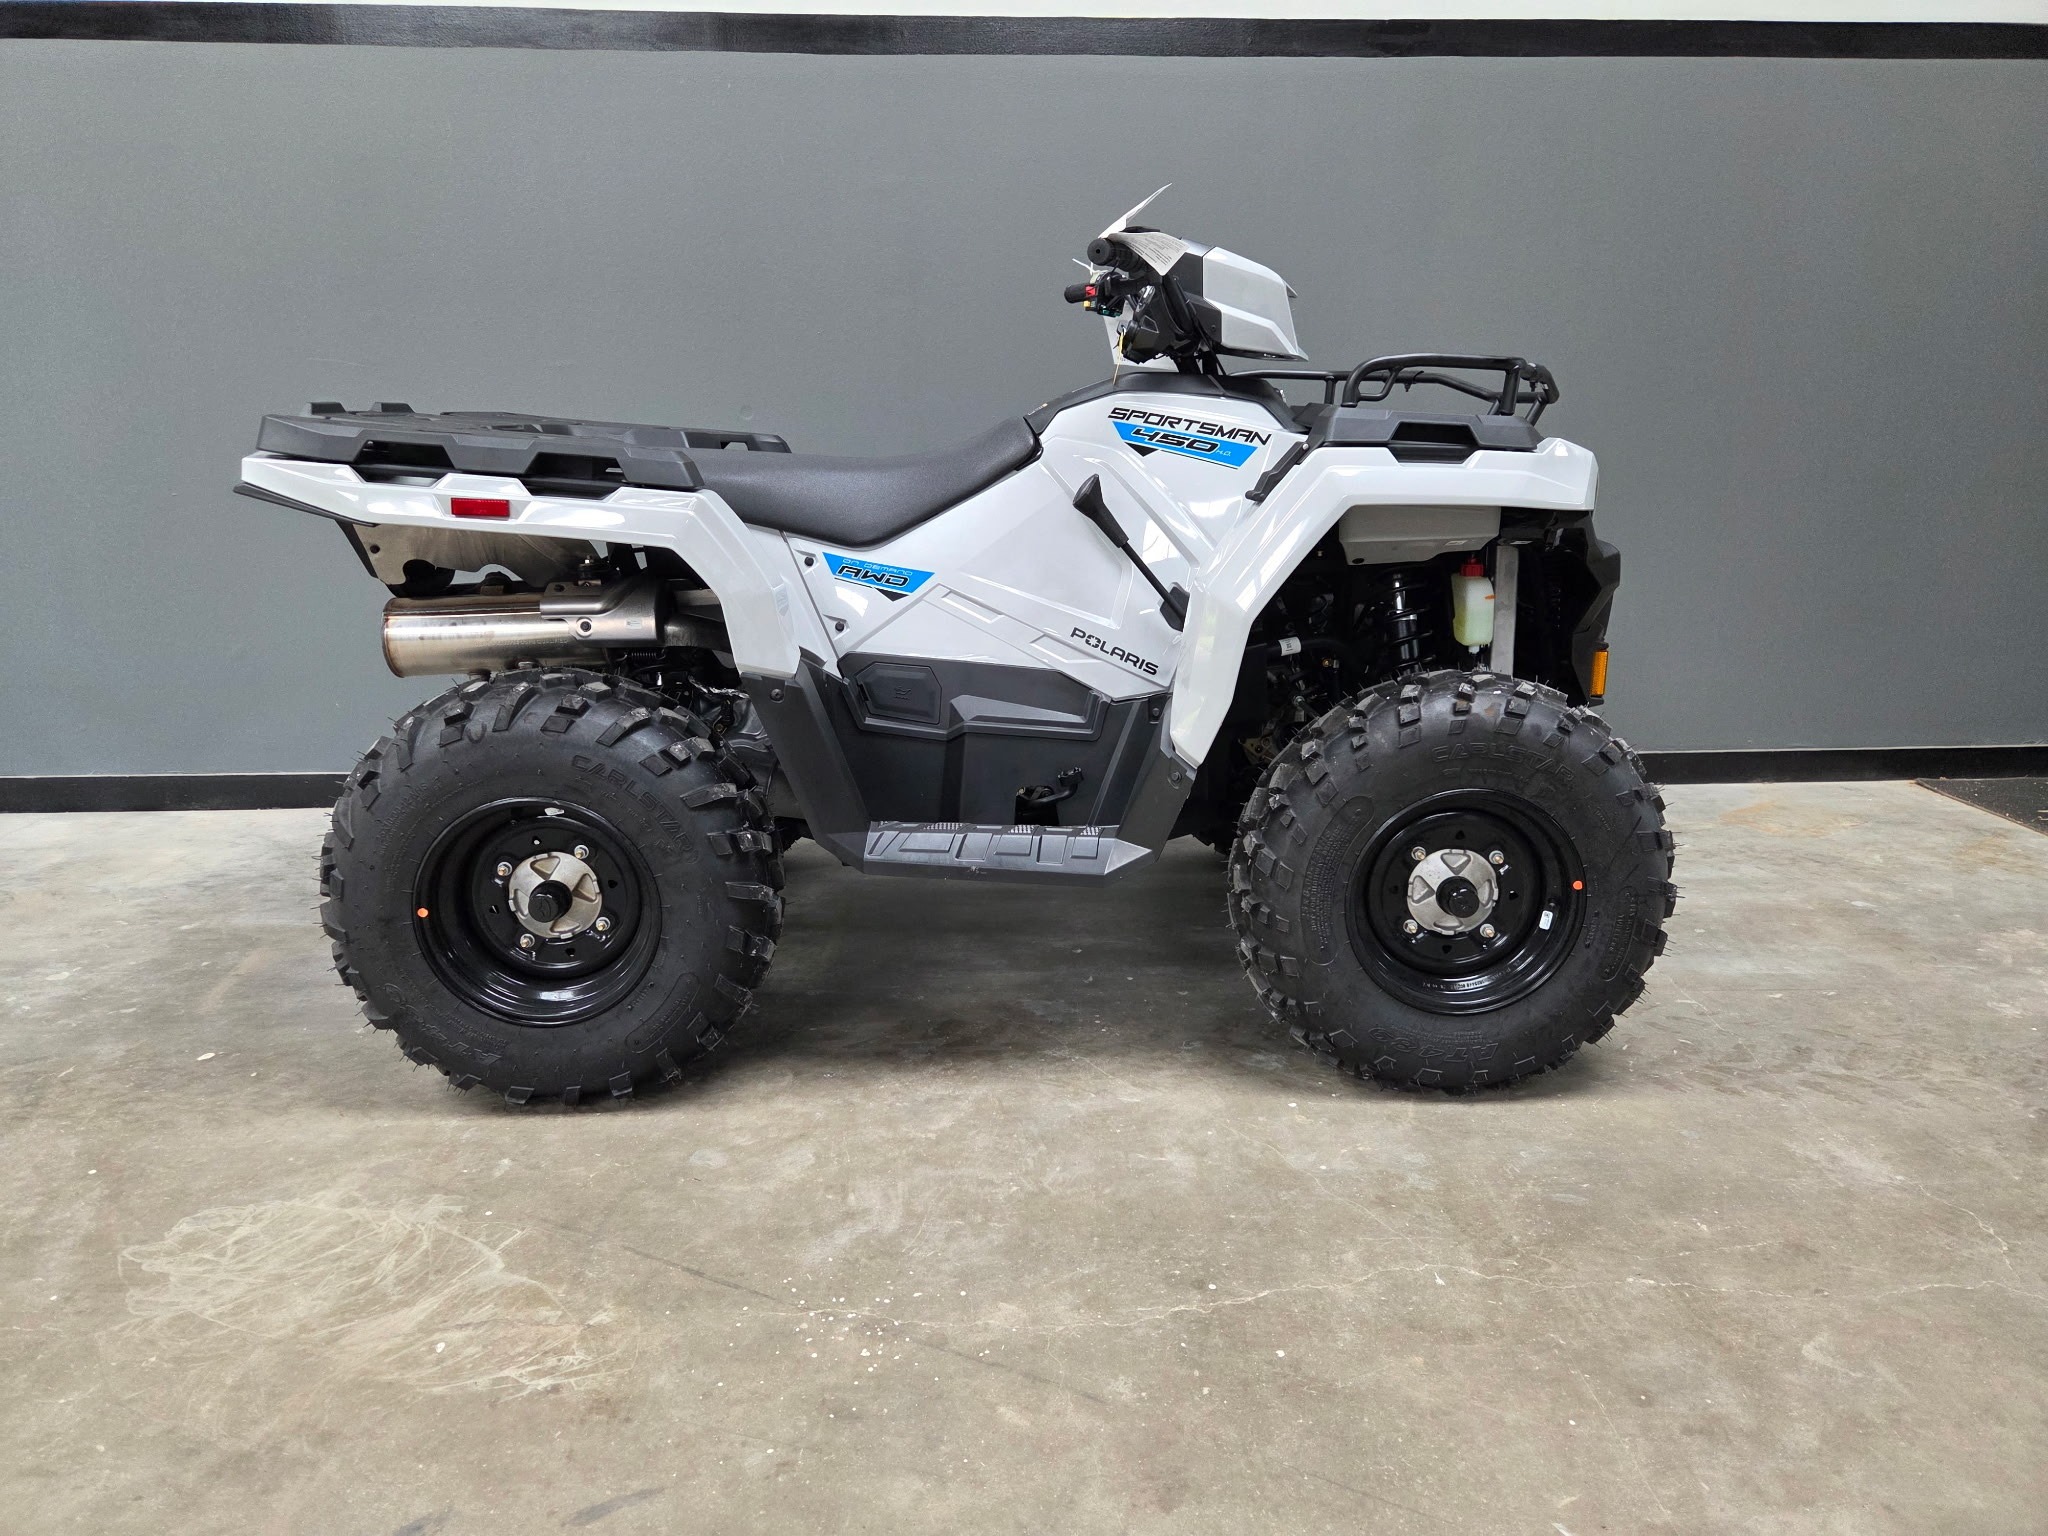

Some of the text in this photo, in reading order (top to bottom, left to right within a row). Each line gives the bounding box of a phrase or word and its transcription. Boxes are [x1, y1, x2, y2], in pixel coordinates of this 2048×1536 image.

[1108, 407, 1272, 446] SPORTSMAN
[1130, 427, 1220, 453] 450
[837, 565, 909, 588] AWD
[1070, 626, 1159, 676] POLARIS
[1431, 741, 1576, 785] CARLSTAR
[571, 755, 690, 852] CARLSTAR
[1368, 1027, 1499, 1063] AT489
